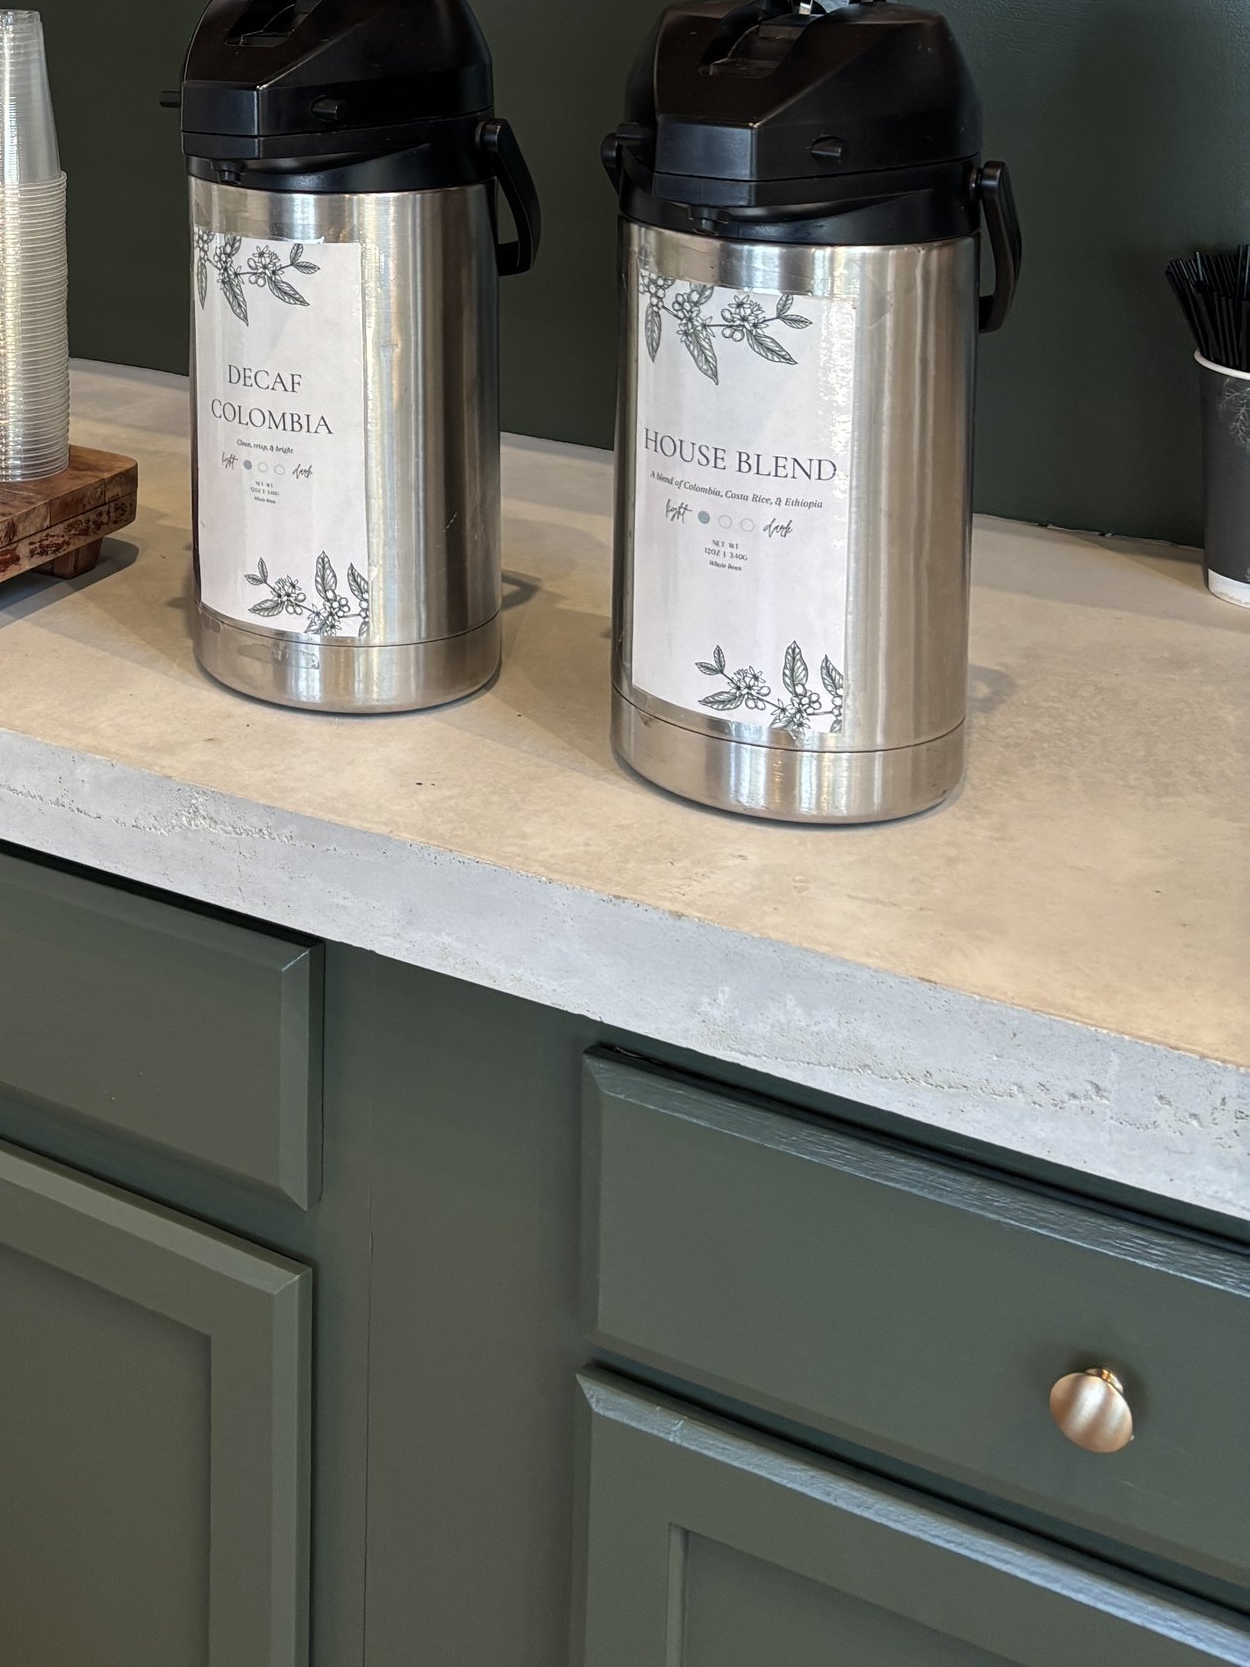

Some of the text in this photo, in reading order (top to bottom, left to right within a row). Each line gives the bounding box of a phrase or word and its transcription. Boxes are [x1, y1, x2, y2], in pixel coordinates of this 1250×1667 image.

[228, 364, 302, 393] DECAF
[211, 398, 334, 435] COLOMBIA
[275, 446, 293, 454] bright
[644, 427, 838, 481] HOUSE BLEND
[650, 470, 823, 510] A blend of Colombia, Costa Rice, & Ethiopia
